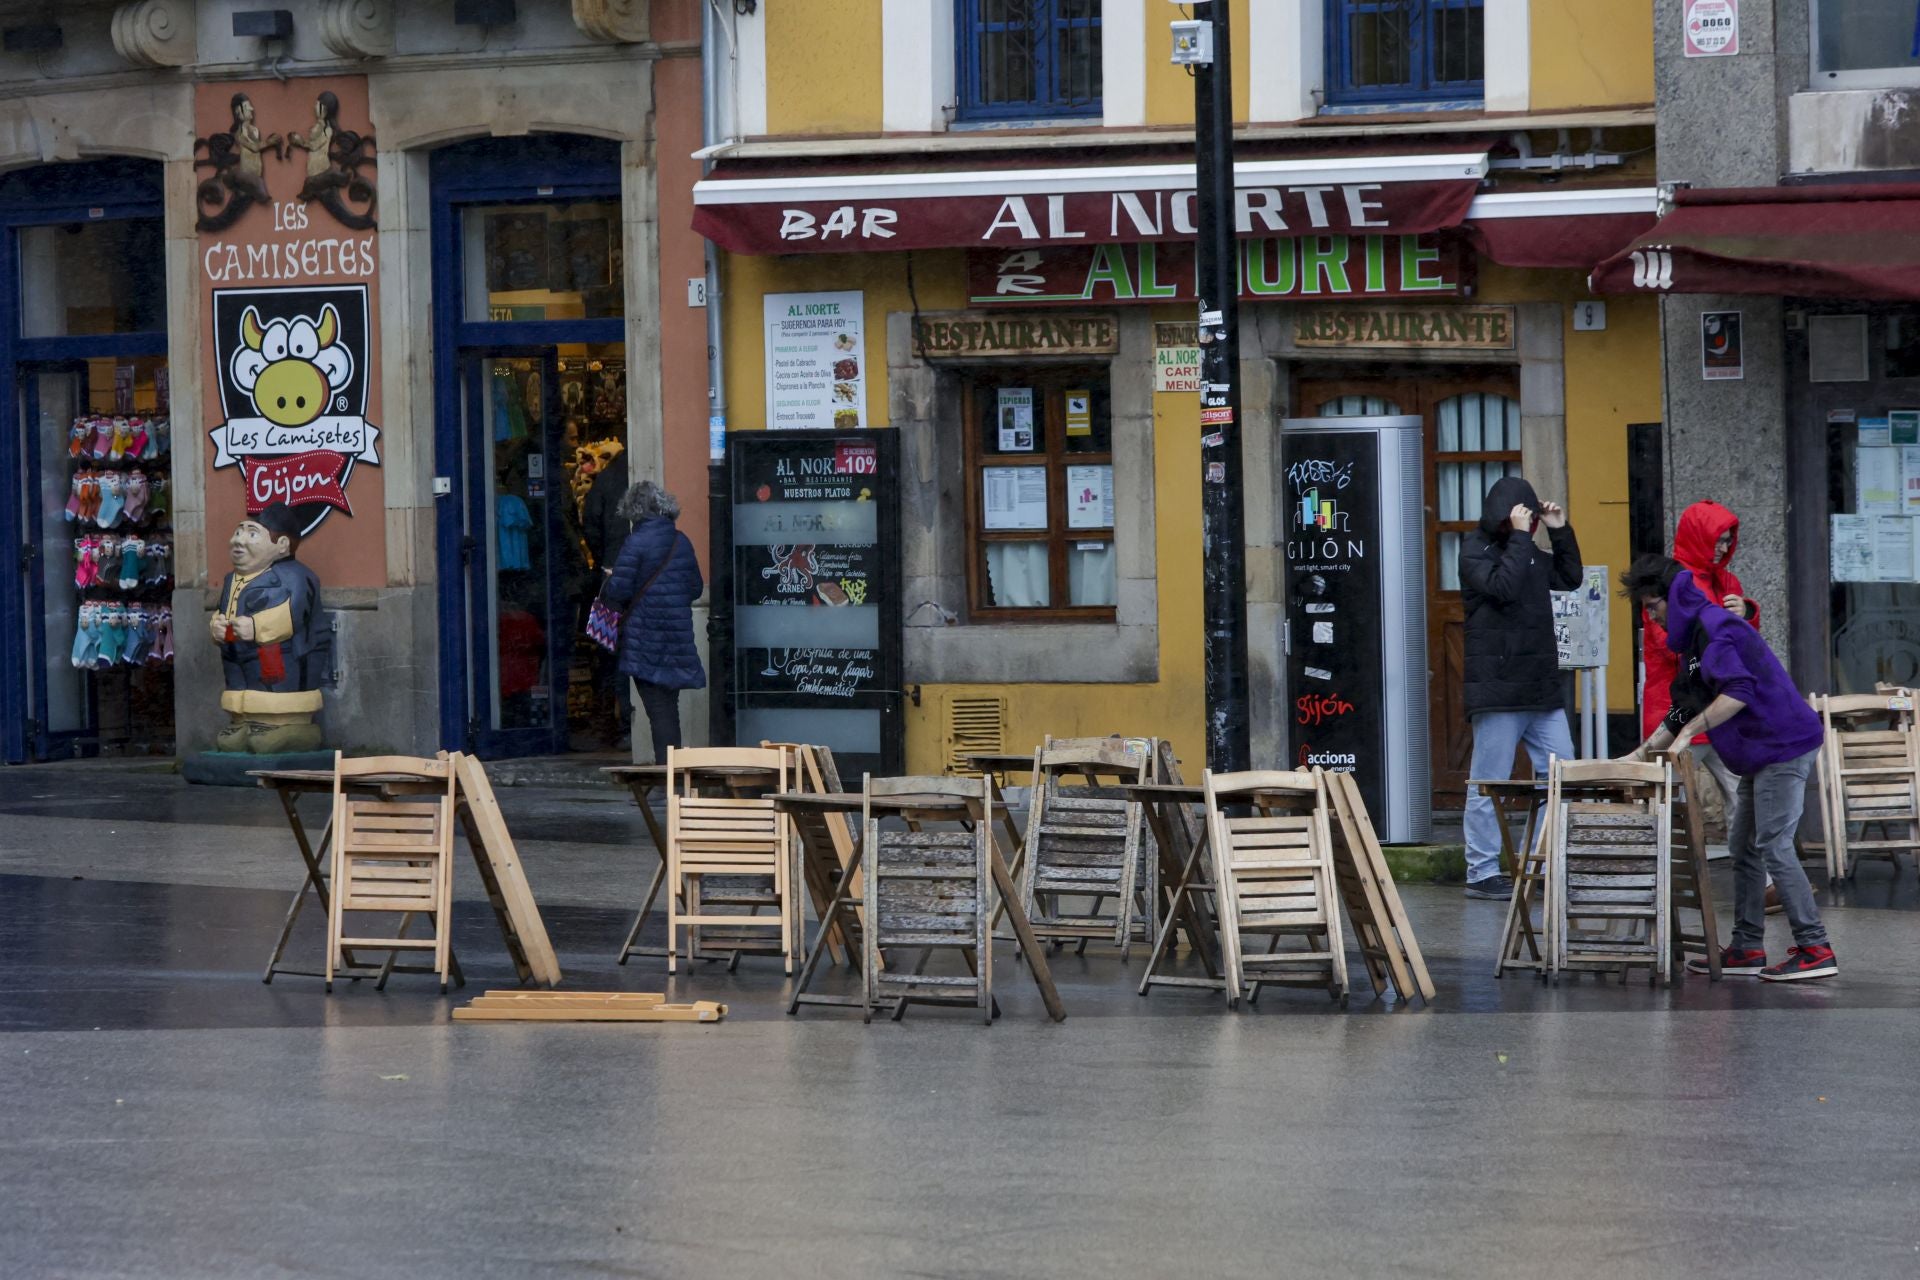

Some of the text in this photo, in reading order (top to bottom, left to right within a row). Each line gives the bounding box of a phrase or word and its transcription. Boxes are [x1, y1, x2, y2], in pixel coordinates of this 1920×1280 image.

[1702, 18, 1731, 27] DOGO
[274, 202, 309, 231] LES
[779, 205, 898, 241] BAR
[982, 194, 1086, 240] AL
[204, 236, 375, 283] CAMISETES
[1081, 235, 1442, 299] AL ORTE
[697, 283, 704, 303] 8
[787, 303, 840, 316] AL NORTE
[1585, 304, 1593, 326] 9
[780, 318, 846, 330] SUGERENCIA PARA HOY
[1299, 311, 1508, 342] RESTAURANTE
[918, 318, 1113, 350] RESTAURANTE
[1158, 349, 1200, 365] AL NOR
[1165, 366, 1200, 377] CART
[230, 422, 361, 450] Les Camisetes
[776, 457, 837, 475] AL NORT
[253, 462, 332, 506] Gijón
[806, 476, 853, 484] RESTAURANTE
[784, 487, 851, 499] NUESTROS PLATOS
[1338, 563, 1351, 572] city
[777, 583, 805, 593] CARNES
[853, 649, 873, 660] una
[825, 664, 839, 676] un
[796, 676, 856, 698] Emblemático
[1296, 692, 1355, 726] gijón
[1307, 750, 1356, 764] acciona
